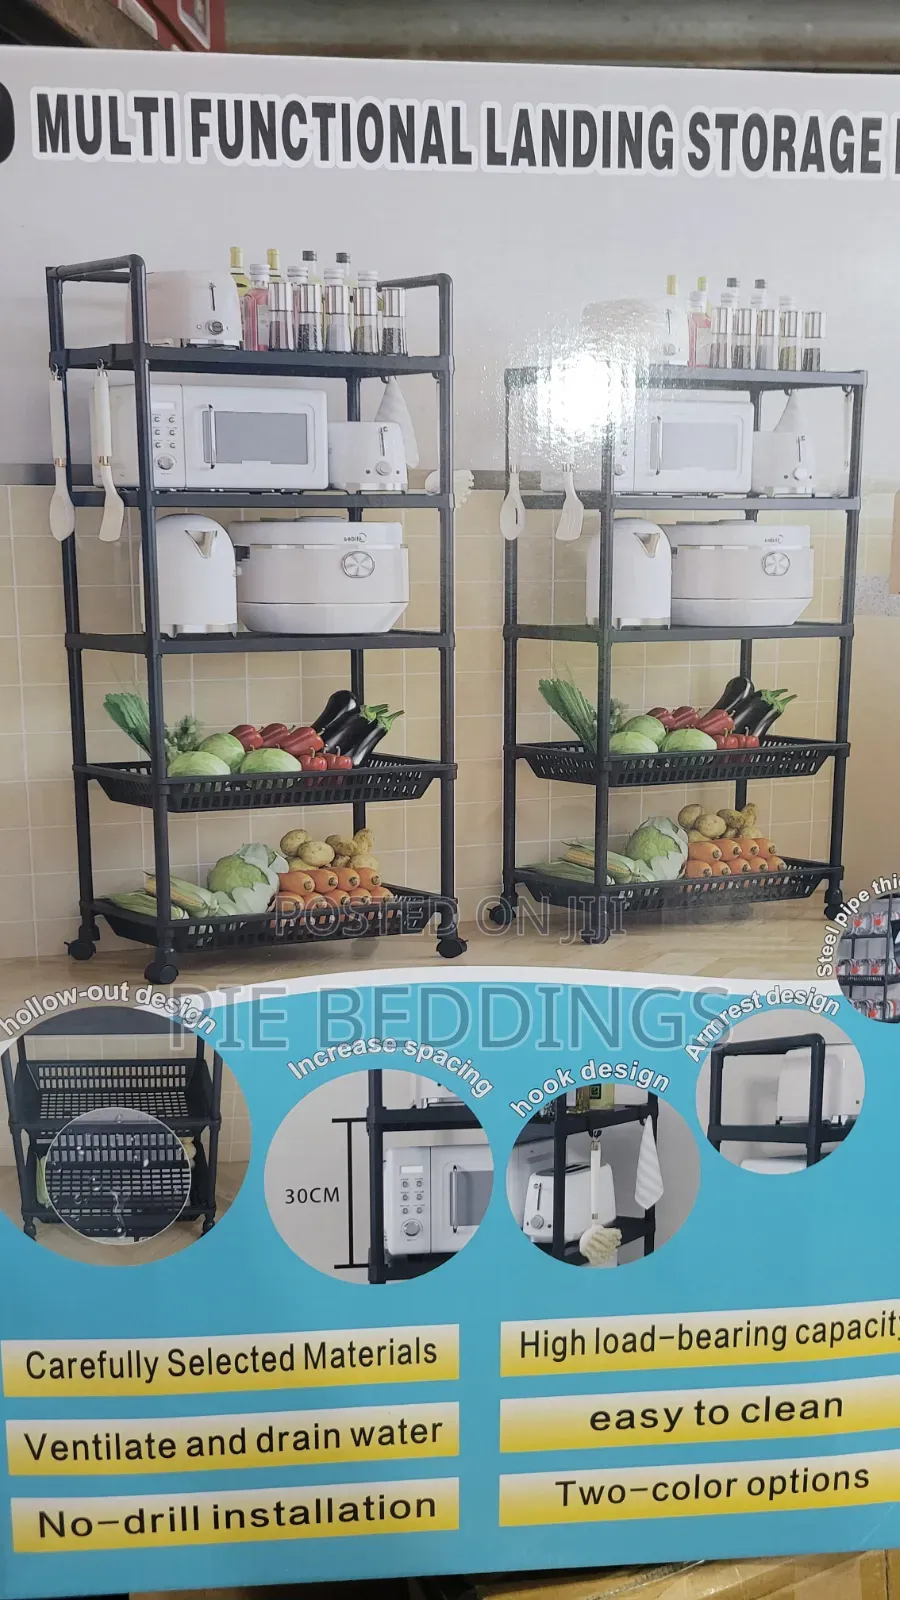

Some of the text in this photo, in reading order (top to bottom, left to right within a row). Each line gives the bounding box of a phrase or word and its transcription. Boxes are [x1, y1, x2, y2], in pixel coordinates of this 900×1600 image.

[37, 93, 176, 157] MULTI
[190, 98, 473, 165] FUNCTIONAL
[486, 107, 674, 170] LANDING
[687, 111, 883, 174] STORAGE
[816, 873, 900, 978] Steel pipe thi
[0, 981, 217, 1037] hollow-out design
[684, 985, 840, 1064] Armrest design
[286, 1037, 495, 1099] Increase spacing
[509, 1059, 671, 1119] hook design
[285, 1186, 340, 1205] 30CM
[26, 1336, 438, 1383] Carefully Selected Materials
[520, 1309, 900, 1362] High load-bearing capacit
[24, 1418, 443, 1461] Ventilate and drain water
[589, 1396, 843, 1432] easy to clean
[555, 1467, 870, 1506] Two-color options
[38, 1494, 436, 1538] No-drill installation
